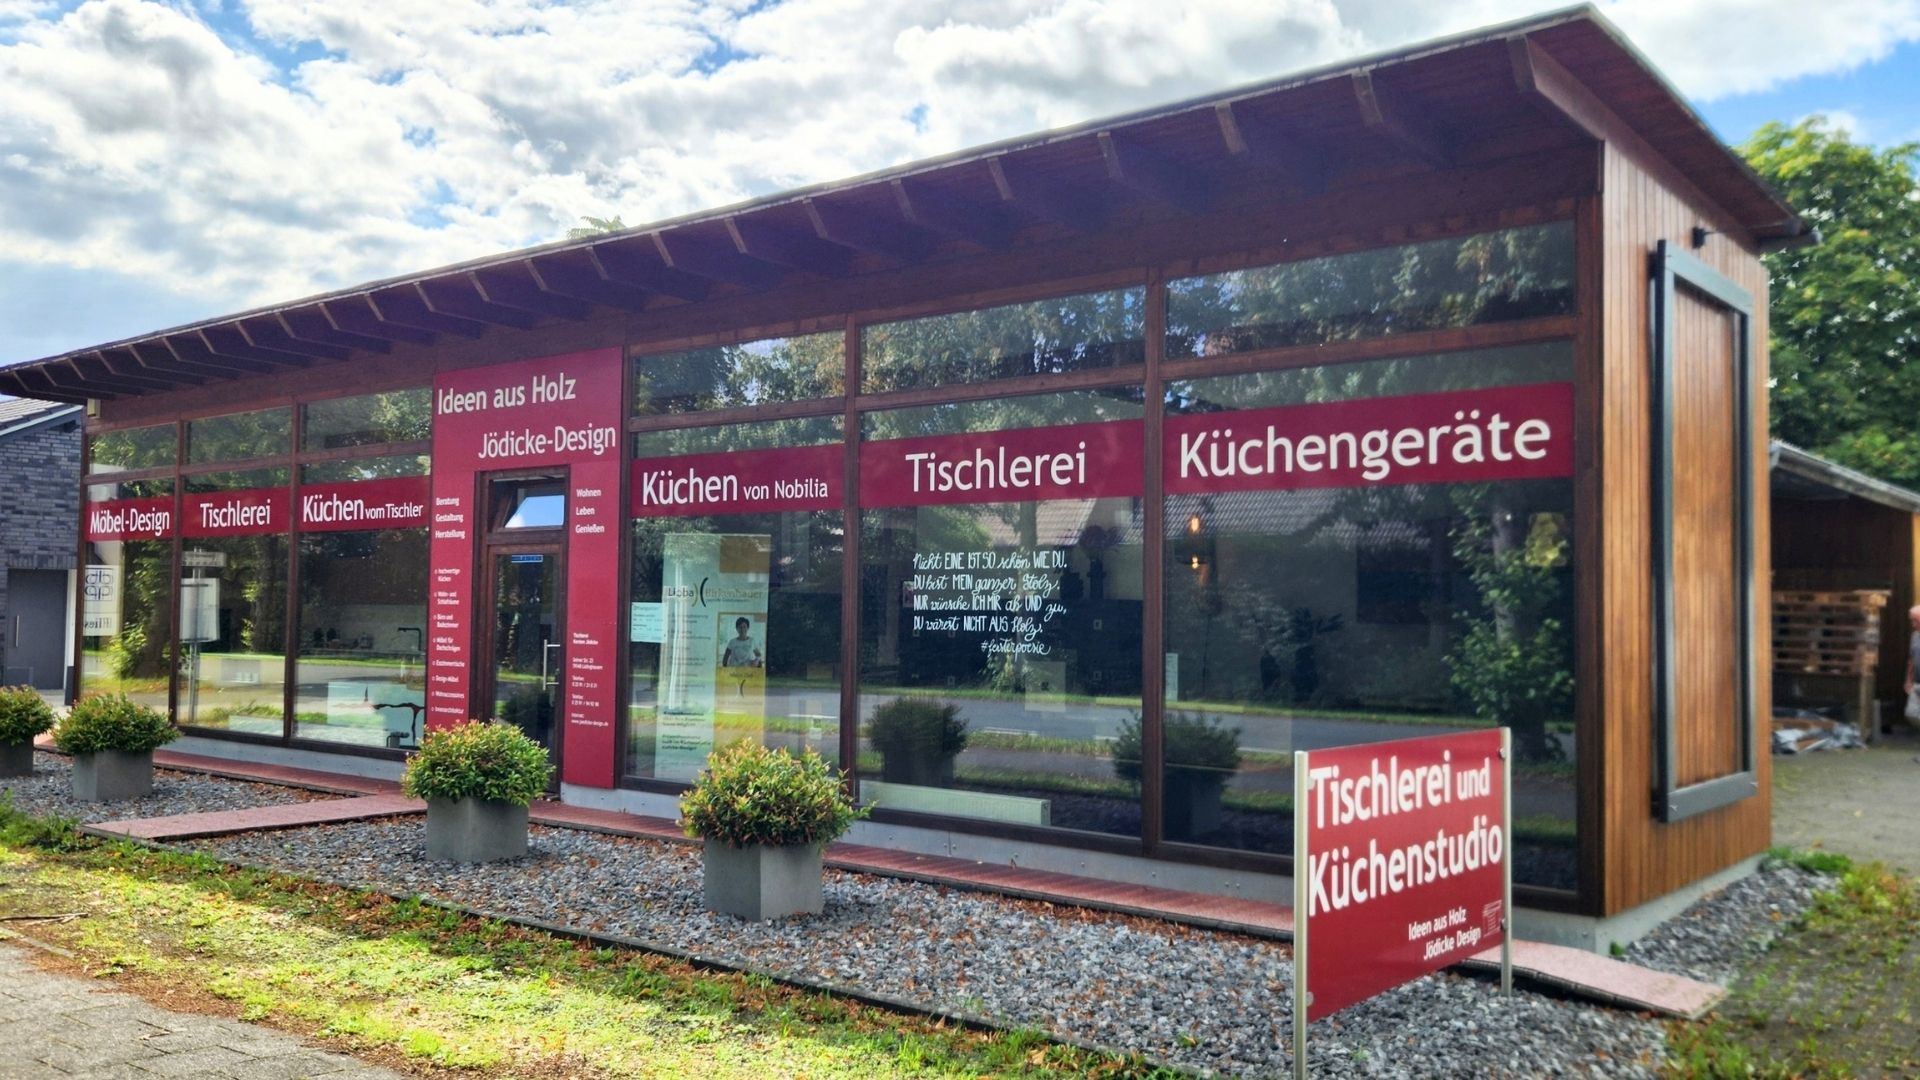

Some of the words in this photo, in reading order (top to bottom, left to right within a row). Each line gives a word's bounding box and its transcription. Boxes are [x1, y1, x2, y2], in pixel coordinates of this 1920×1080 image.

[438, 389, 486, 415] Ideen
[493, 386, 525, 408] aus
[532, 372, 576, 403] Holz
[478, 423, 616, 459] Jödicke-Design
[1180, 410, 1551, 481] Küchengeräte
[905, 441, 1086, 492] Tischlerei
[576, 489, 602, 497] Wohnen
[643, 468, 738, 505] Küchen
[744, 484, 769, 500] von
[775, 479, 828, 499] Nobilia
[90, 509, 171, 537] Möbel-Design
[200, 499, 271, 528] Tischlerei
[303, 494, 364, 523] Küchen
[365, 508, 386, 520] vom
[387, 503, 423, 519] Tischler
[435, 514, 464, 523] Gestaltung
[576, 507, 595, 515] Leben
[435, 530, 466, 539] Herstellung
[575, 525, 605, 533] Genießen
[913, 553, 942, 570] Nicht
[945, 552, 964, 569] EINE
[968, 552, 982, 569] IST
[983, 552, 996, 569] SO
[997, 552, 1030, 569] schön
[1033, 551, 1049, 568] WIE
[1053, 551, 1067, 568] DU.
[913, 575, 925, 590] DU
[925, 575, 949, 590] bist
[953, 575, 973, 589] MEIN
[972, 577, 1016, 595] ganzer
[1023, 574, 1060, 598] Stolz.
[913, 595, 928, 611] NUR
[930, 595, 970, 610] wünsche
[972, 594, 986, 611] ICH
[987, 595, 1001, 611] MIR
[1005, 596, 1022, 612] ab
[1025, 595, 1042, 611] UND
[1044, 603, 1066, 622] zu,
[913, 616, 923, 630] DU
[926, 617, 960, 630] wärest
[963, 616, 987, 631] NICHT
[989, 616, 1008, 632] AUS
[1011, 616, 1043, 641] Holz.
[1310, 750, 1450, 829] Tischlerei
[1455, 757, 1490, 801] und
[1309, 815, 1502, 917] Küchenstudio
[1408, 920, 1432, 941] Ideen
[1433, 914, 1447, 932] aus
[1448, 907, 1466, 926] Holz
[1423, 934, 1455, 961] Jödicke
[1456, 926, 1481, 947] Design
